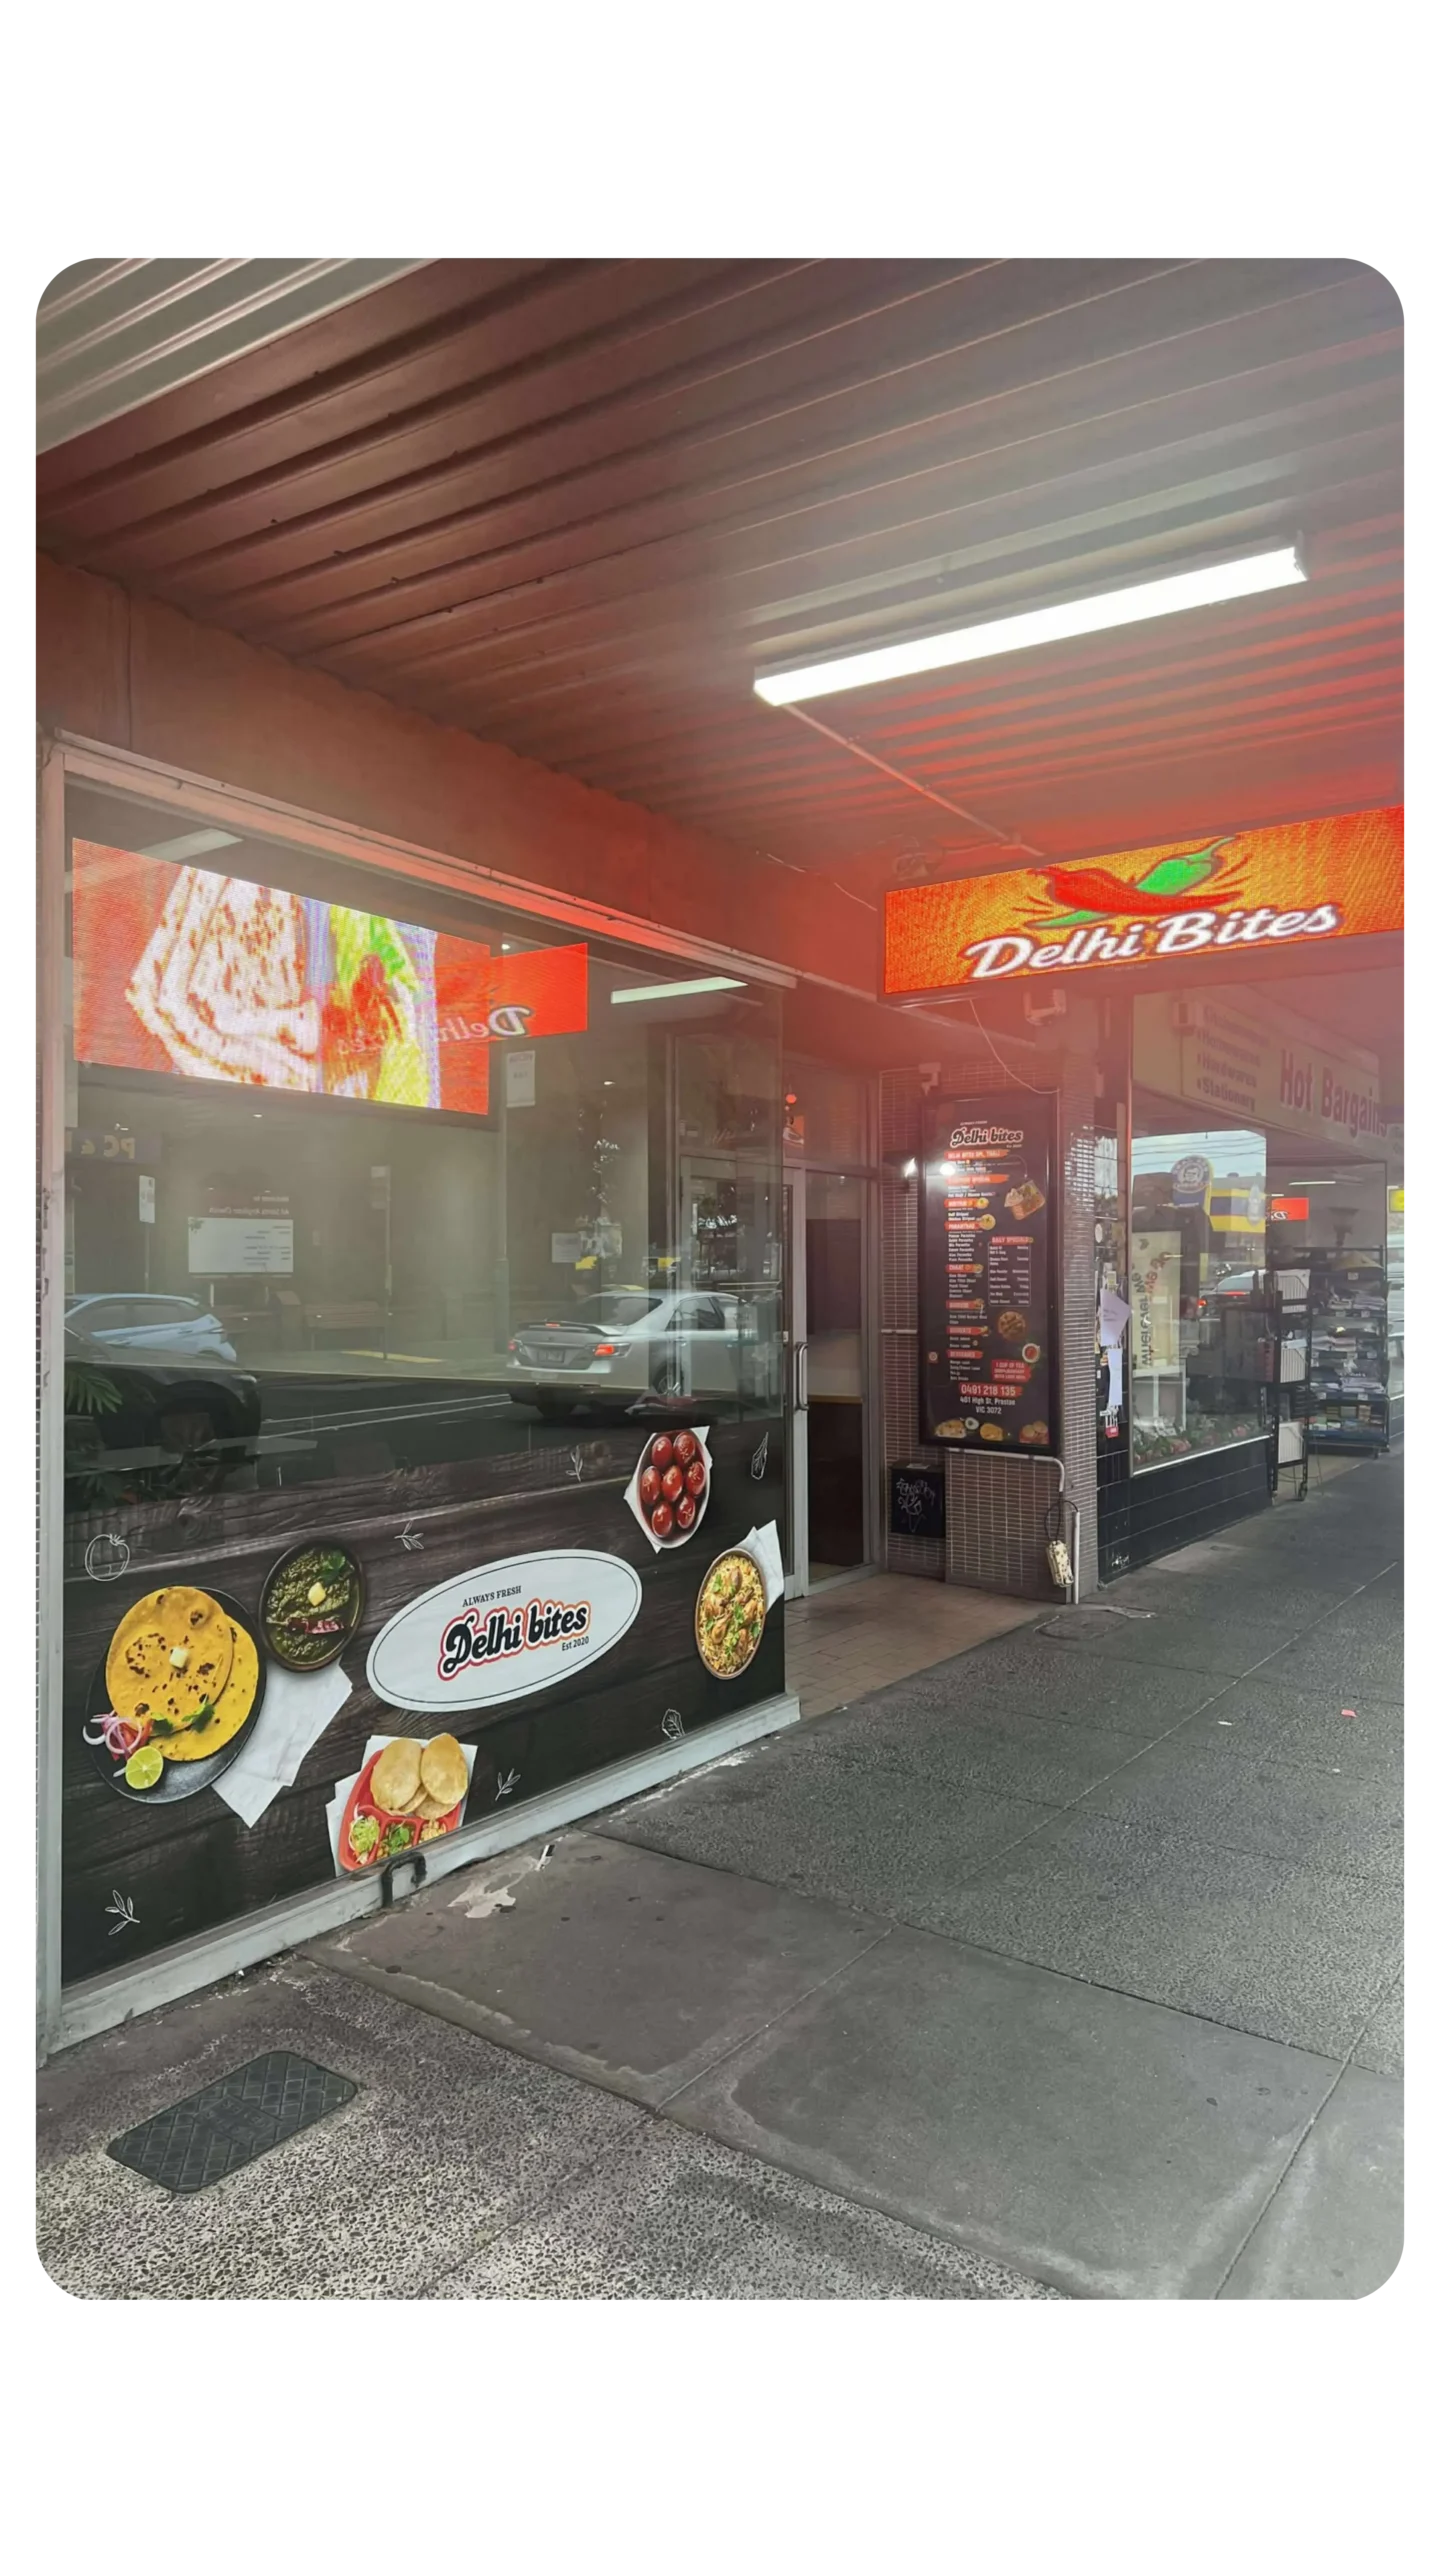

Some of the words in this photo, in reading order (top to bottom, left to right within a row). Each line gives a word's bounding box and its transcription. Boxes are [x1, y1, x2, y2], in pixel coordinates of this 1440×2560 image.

[964, 925, 1143, 979] Delhi
[1155, 904, 1339, 955] Bites
[1202, 1052, 1257, 1088] Hardwares
[1279, 1047, 1314, 1112] Hot
[950, 1127, 988, 1148] Delhi
[989, 1127, 1023, 1143] bites
[961, 1384, 981, 1395] 0491
[983, 1385, 998, 1395] 218
[1001, 1385, 1016, 1395] 135
[972, 1397, 984, 1405] High
[986, 1406, 1001, 1414] 3072
[462, 1591, 495, 1608] ALWAYS
[496, 1585, 522, 1600] FRESH
[440, 1610, 523, 1676] Delhi
[526, 1600, 589, 1647] bites
[561, 1642, 573, 1651] Est
[573, 1636, 590, 1649] 2020
